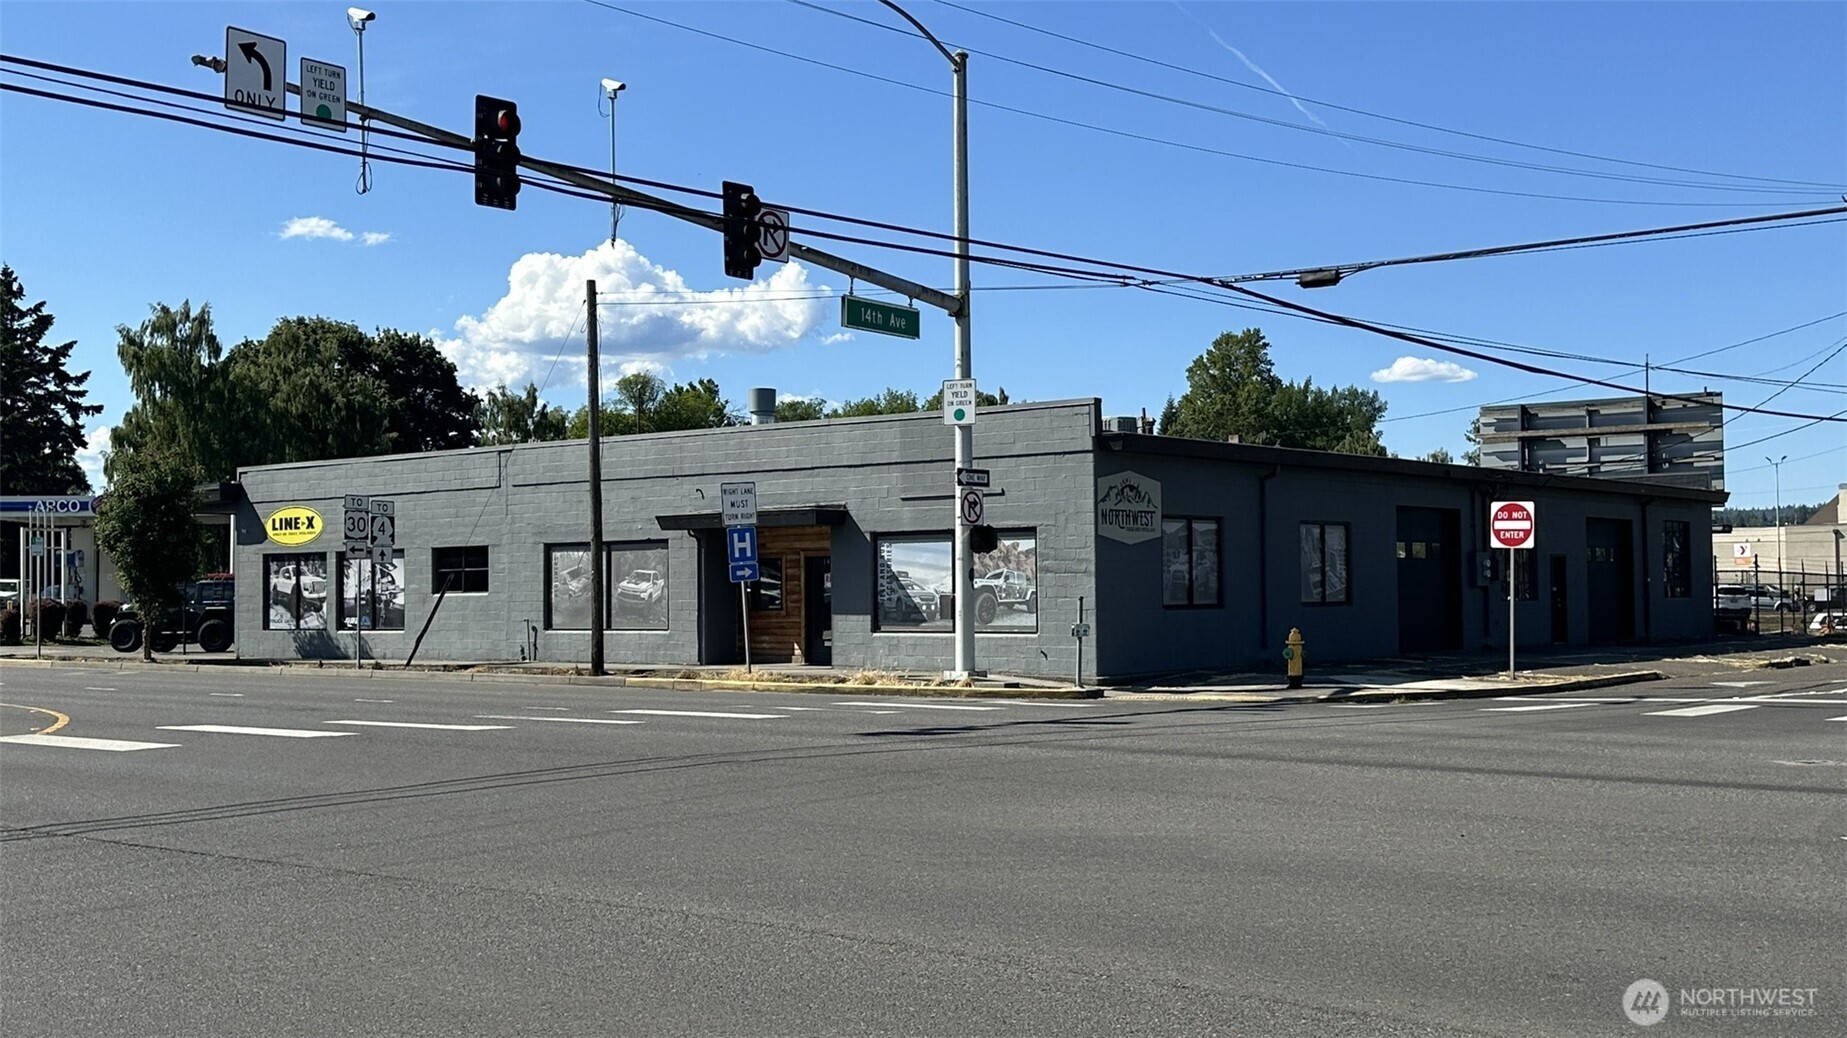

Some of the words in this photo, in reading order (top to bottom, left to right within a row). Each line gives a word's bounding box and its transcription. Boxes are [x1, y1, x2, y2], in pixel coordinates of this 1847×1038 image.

[306, 64, 322, 74] LEFT
[324, 68, 341, 80] TURN
[312, 77, 336, 91] YIELD
[234, 88, 276, 109] ONLY
[306, 89, 316, 99] ON
[319, 92, 341, 104] GREEN
[861, 307, 883, 325] 14th
[889, 313, 906, 329] Ave
[950, 390, 969, 399] YIELD
[723, 487, 739, 496] RIGHT
[740, 487, 754, 495] LANE
[34, 499, 81, 513] ARCO
[350, 498, 363, 507] TO
[376, 503, 389, 512] TO
[730, 499, 748, 509] MUST
[725, 512, 739, 521] TURN
[740, 511, 755, 520] RIGHT
[1101, 508, 1156, 529] NORTHWEST
[1497, 511, 1509, 519] DO
[1511, 511, 1528, 519] NOT
[346, 516, 367, 533] 30
[377, 521, 386, 536] 4
[1500, 530, 1525, 539] ENTER
[733, 532, 752, 558] H
